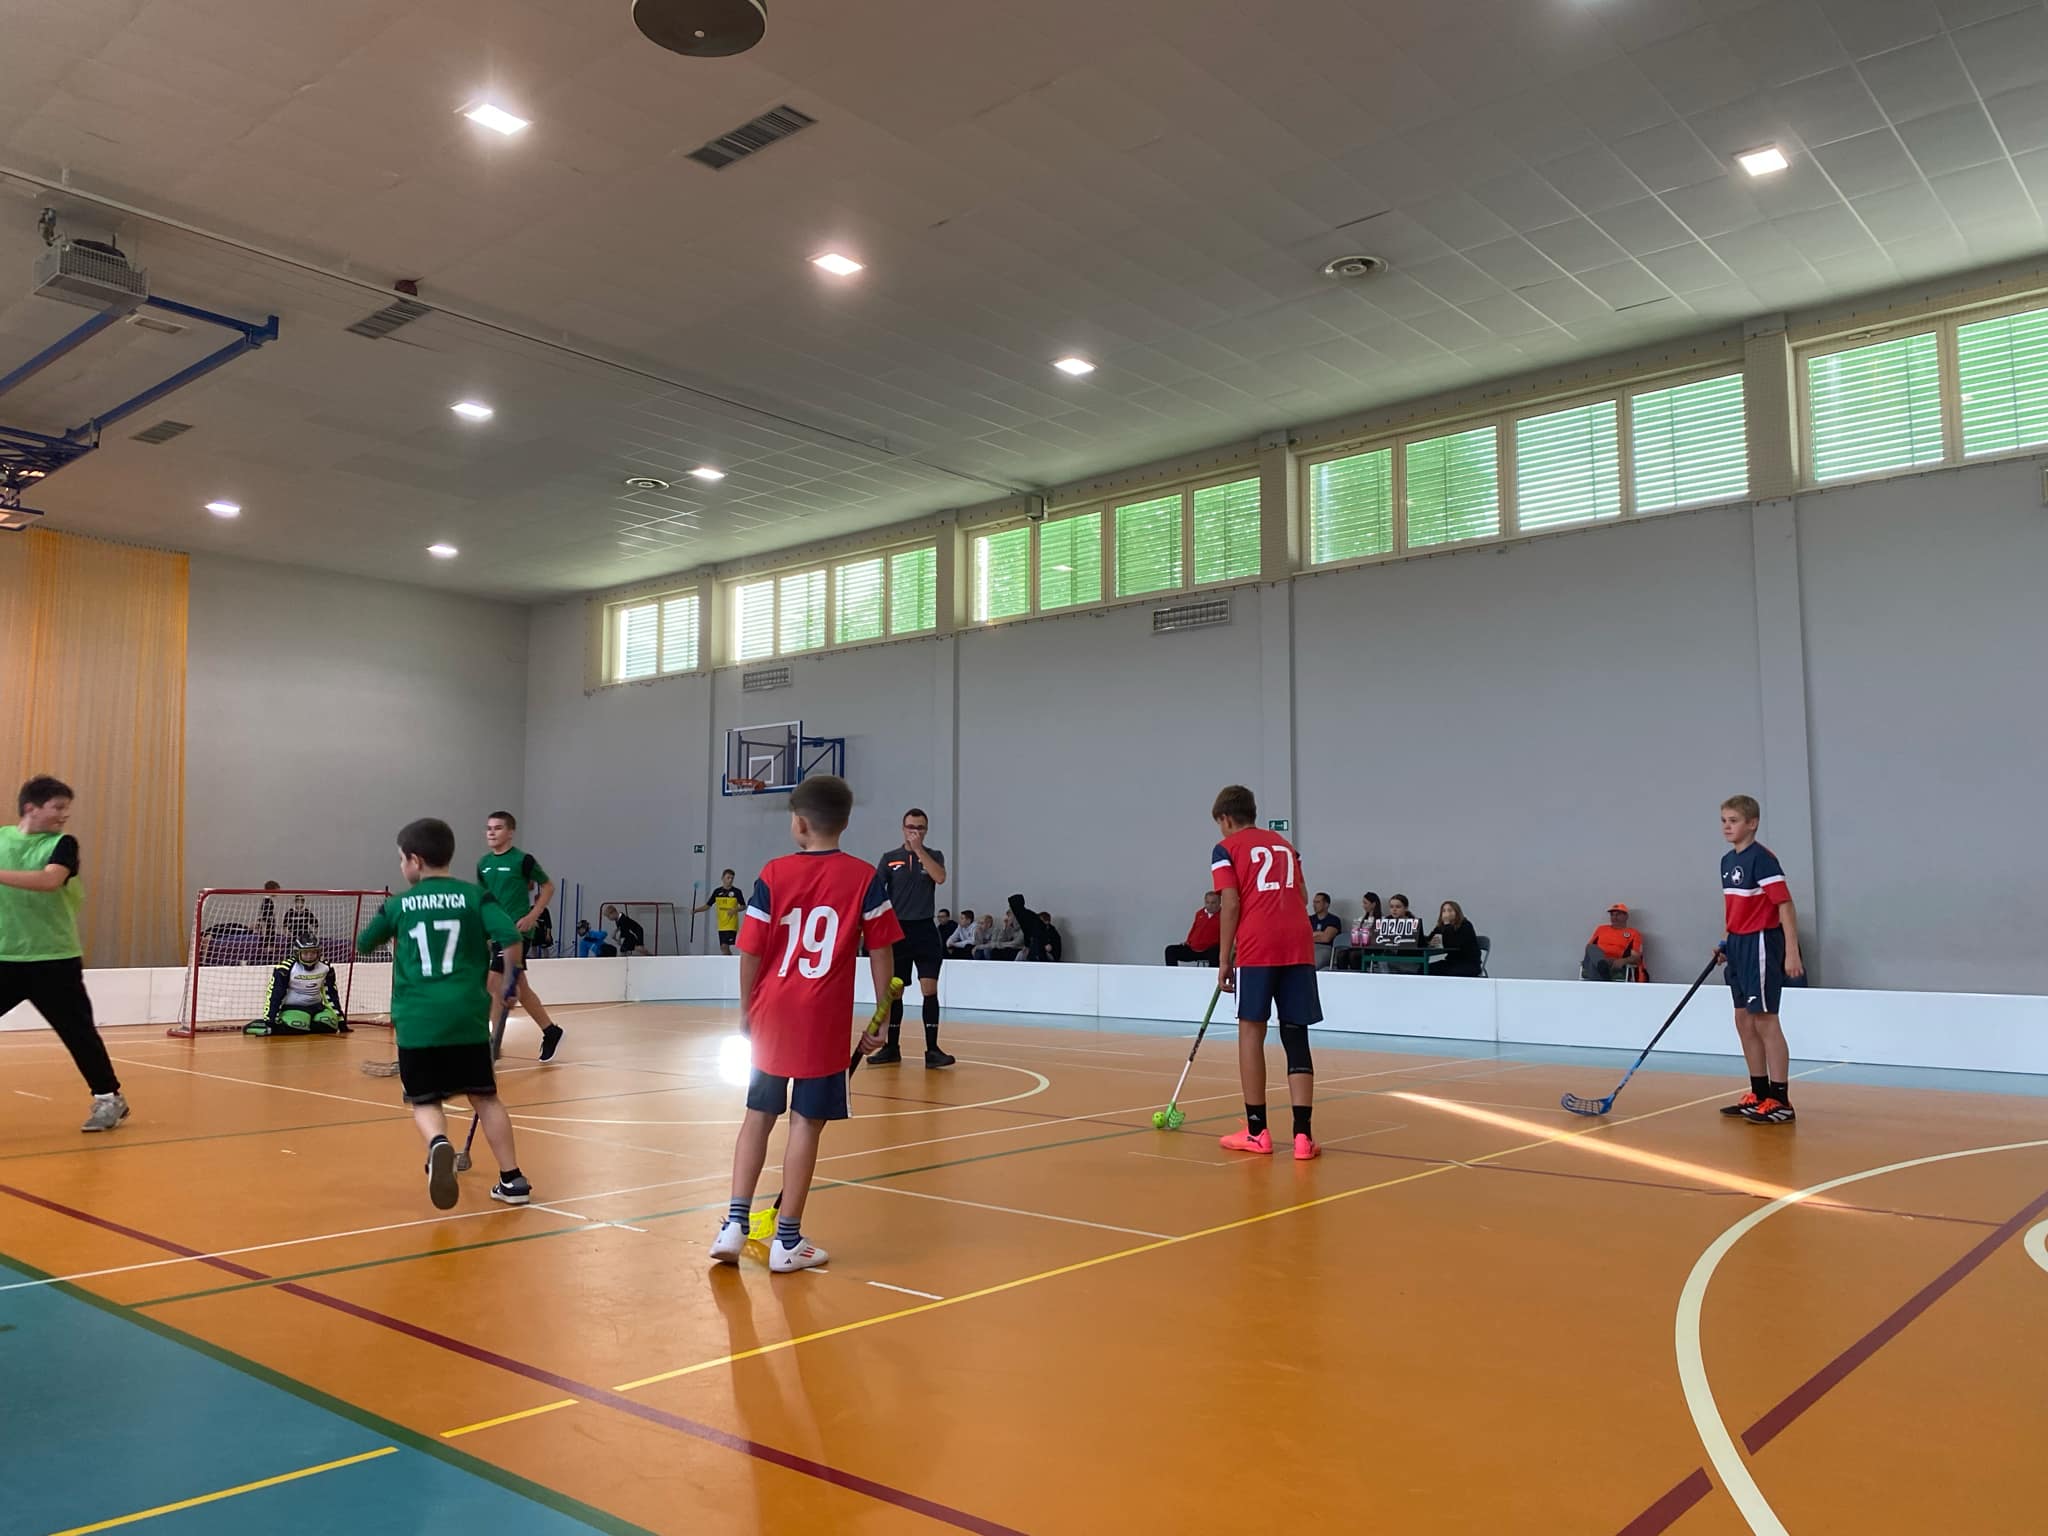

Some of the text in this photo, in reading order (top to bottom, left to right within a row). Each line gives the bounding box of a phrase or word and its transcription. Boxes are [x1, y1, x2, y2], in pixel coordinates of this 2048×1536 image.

[1250, 845, 1294, 892] 27
[401, 893, 466, 913] POTARZYCA
[408, 919, 461, 977] 17
[778, 905, 839, 979] 19
